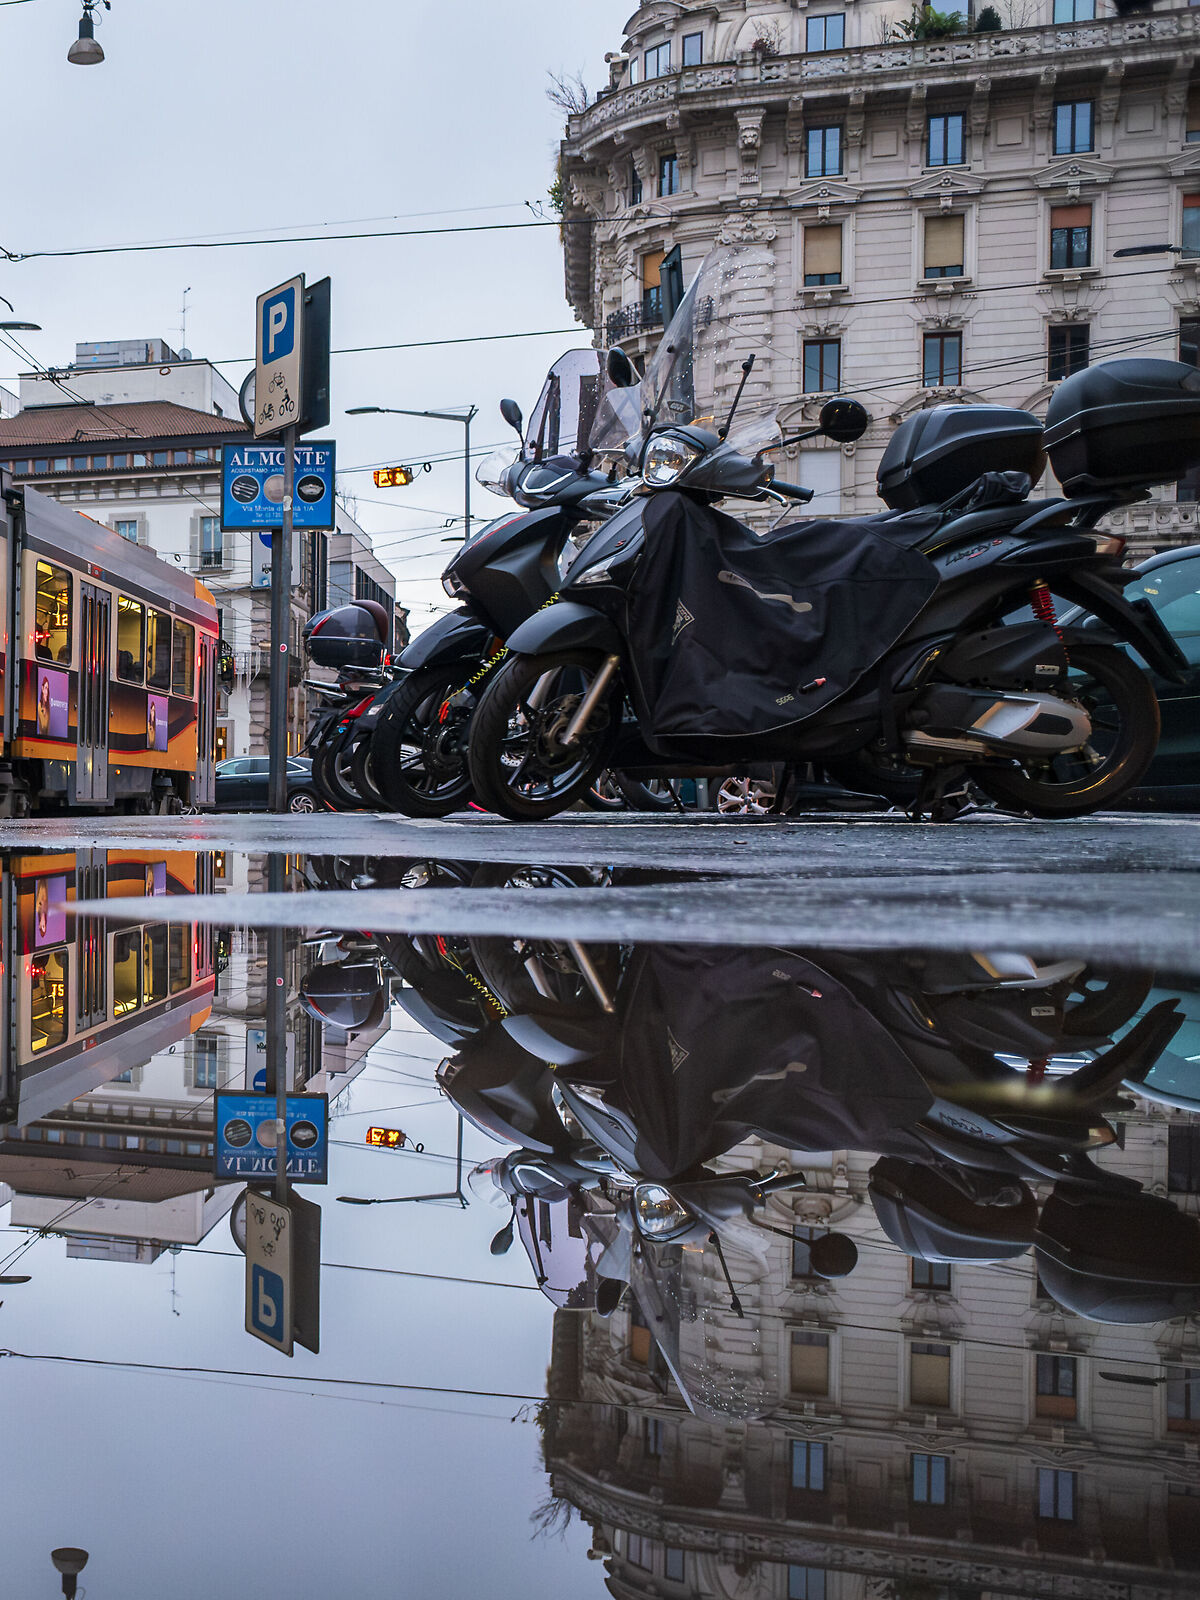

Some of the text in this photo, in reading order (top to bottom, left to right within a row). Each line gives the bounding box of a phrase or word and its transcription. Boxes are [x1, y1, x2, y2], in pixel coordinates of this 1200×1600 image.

[268, 301, 288, 354] P
[230, 452, 254, 466] AL
[55, 613, 68, 626] 12
